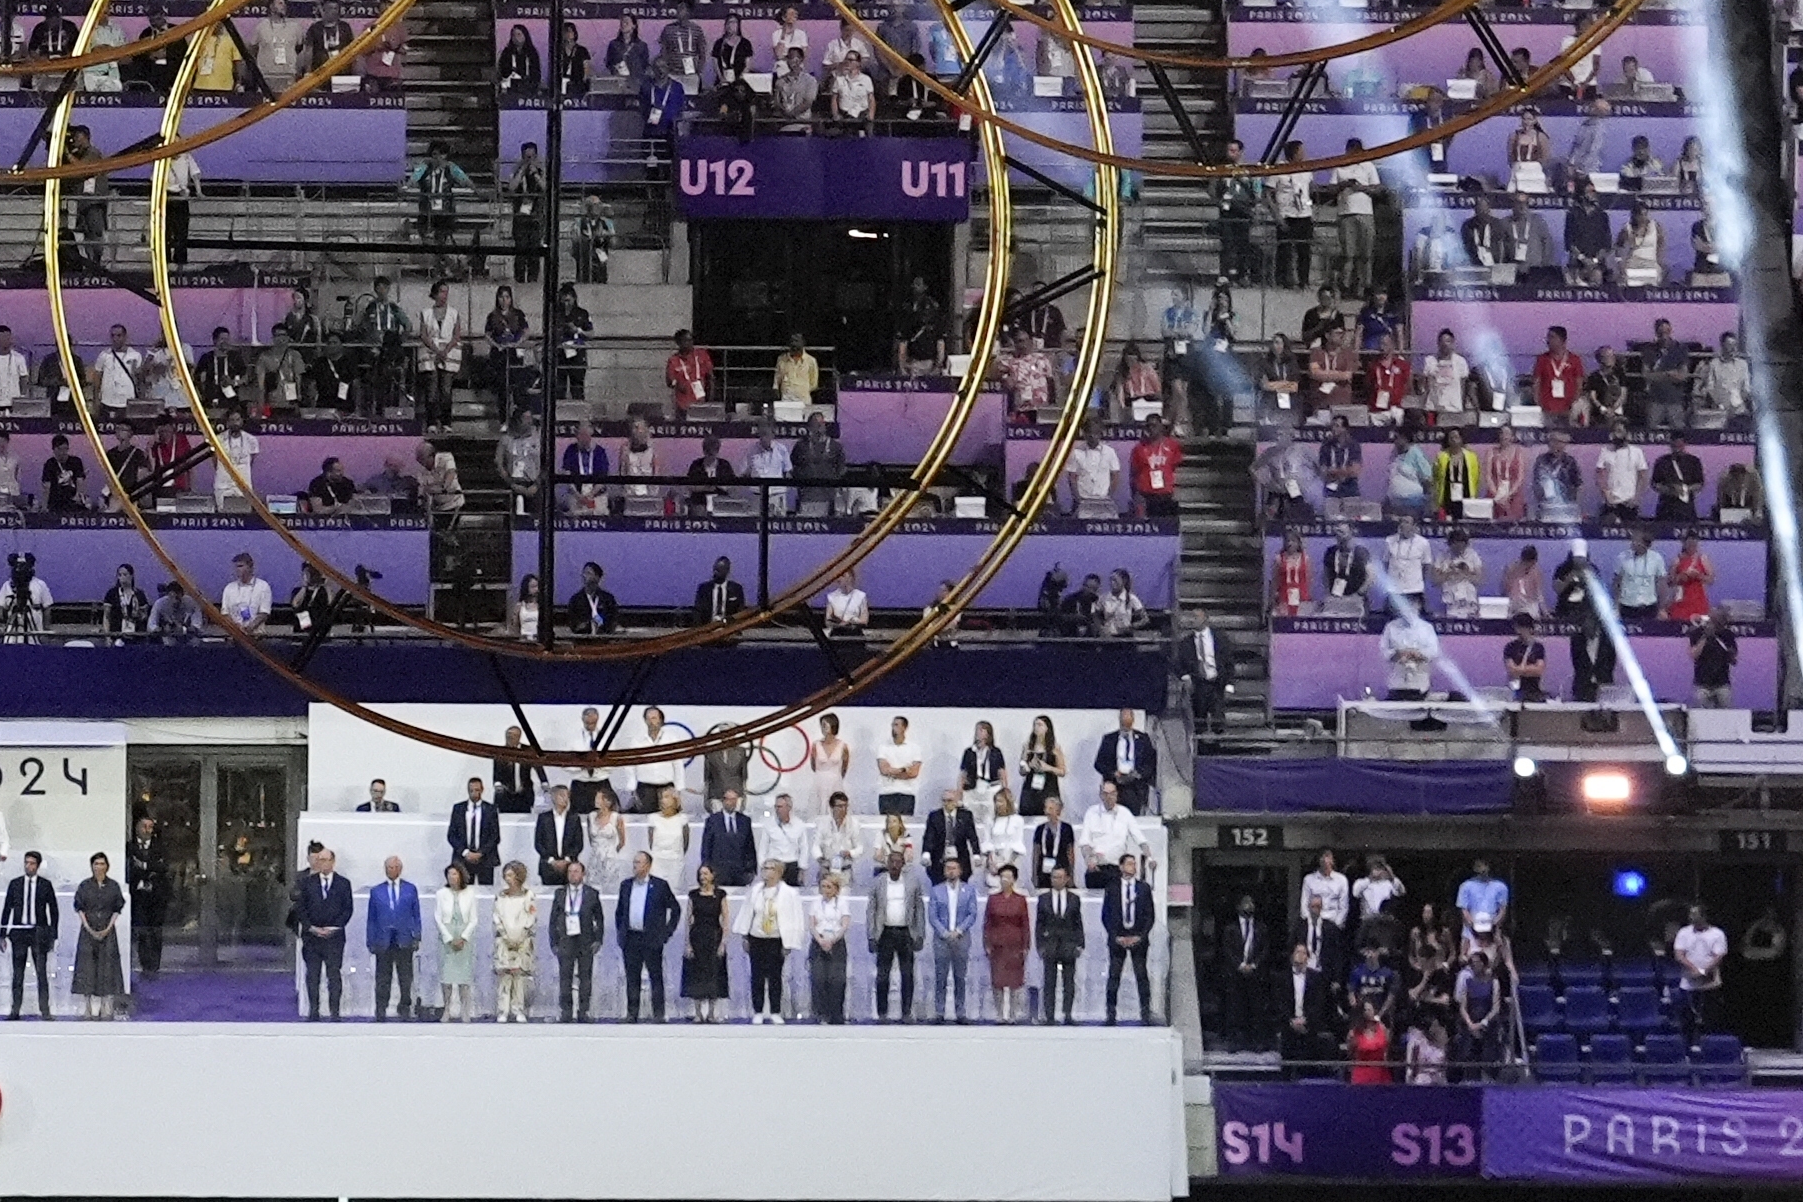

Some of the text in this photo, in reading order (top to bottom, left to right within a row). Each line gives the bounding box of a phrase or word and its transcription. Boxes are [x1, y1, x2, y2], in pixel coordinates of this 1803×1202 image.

[91, 94, 122, 105] 2024
[197, 94, 229, 106] 2024
[680, 159, 965, 197] U12 U11
[261, 421, 294, 433] 2024
[62, 516, 97, 527] PARIS
[173, 516, 245, 528] PARIS 2024
[319, 516, 351, 528] 2024
[574, 517, 606, 529] 2024
[646, 518, 718, 530] PARIS 2024
[796, 520, 829, 532] 2024
[1233, 828, 1268, 847] 152
[1737, 832, 1771, 850] 151
[1223, 1121, 1476, 1165] S14 S13
